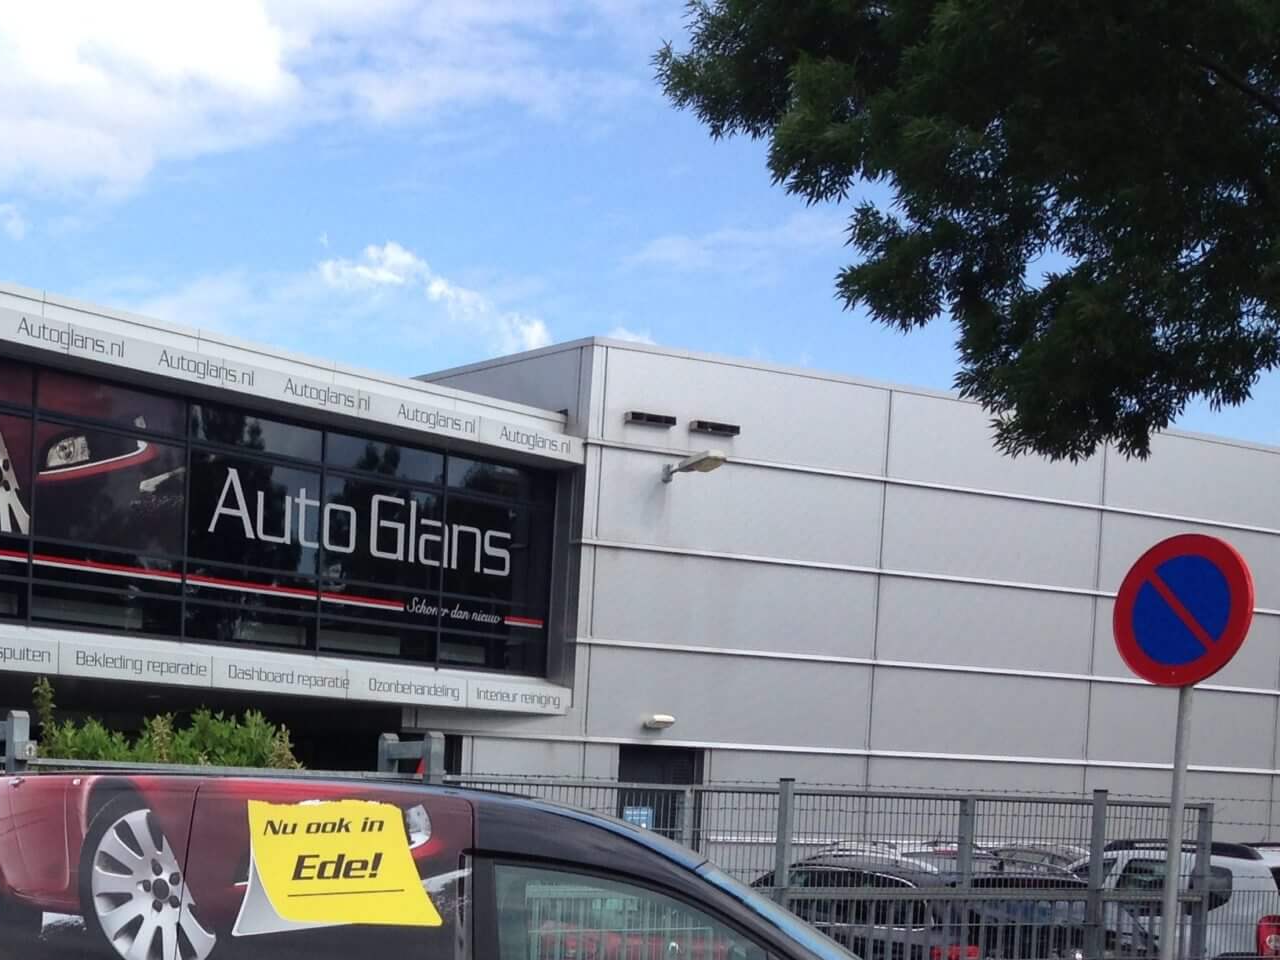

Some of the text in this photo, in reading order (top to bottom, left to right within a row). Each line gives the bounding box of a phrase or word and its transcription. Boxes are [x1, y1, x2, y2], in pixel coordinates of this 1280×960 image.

[17, 317, 125, 358] Autoglans.nl
[158, 349, 254, 387] Autoglans.nl
[284, 377, 370, 411] Autoglans.nl
[397, 403, 475, 433] Autoglans.nl
[499, 425, 571, 454] Autoglans.nl
[208, 467, 512, 577] Auto Glans
[406, 597, 501, 624] Schonr dan nieuw
[75, 650, 207, 677] Bekleding reparatie
[228, 664, 350, 690] Dashboard reparatie
[369, 677, 460, 701] Ozonbehandeling
[264, 817, 385, 836] Nu ook in
[291, 852, 383, 881] Ede!
